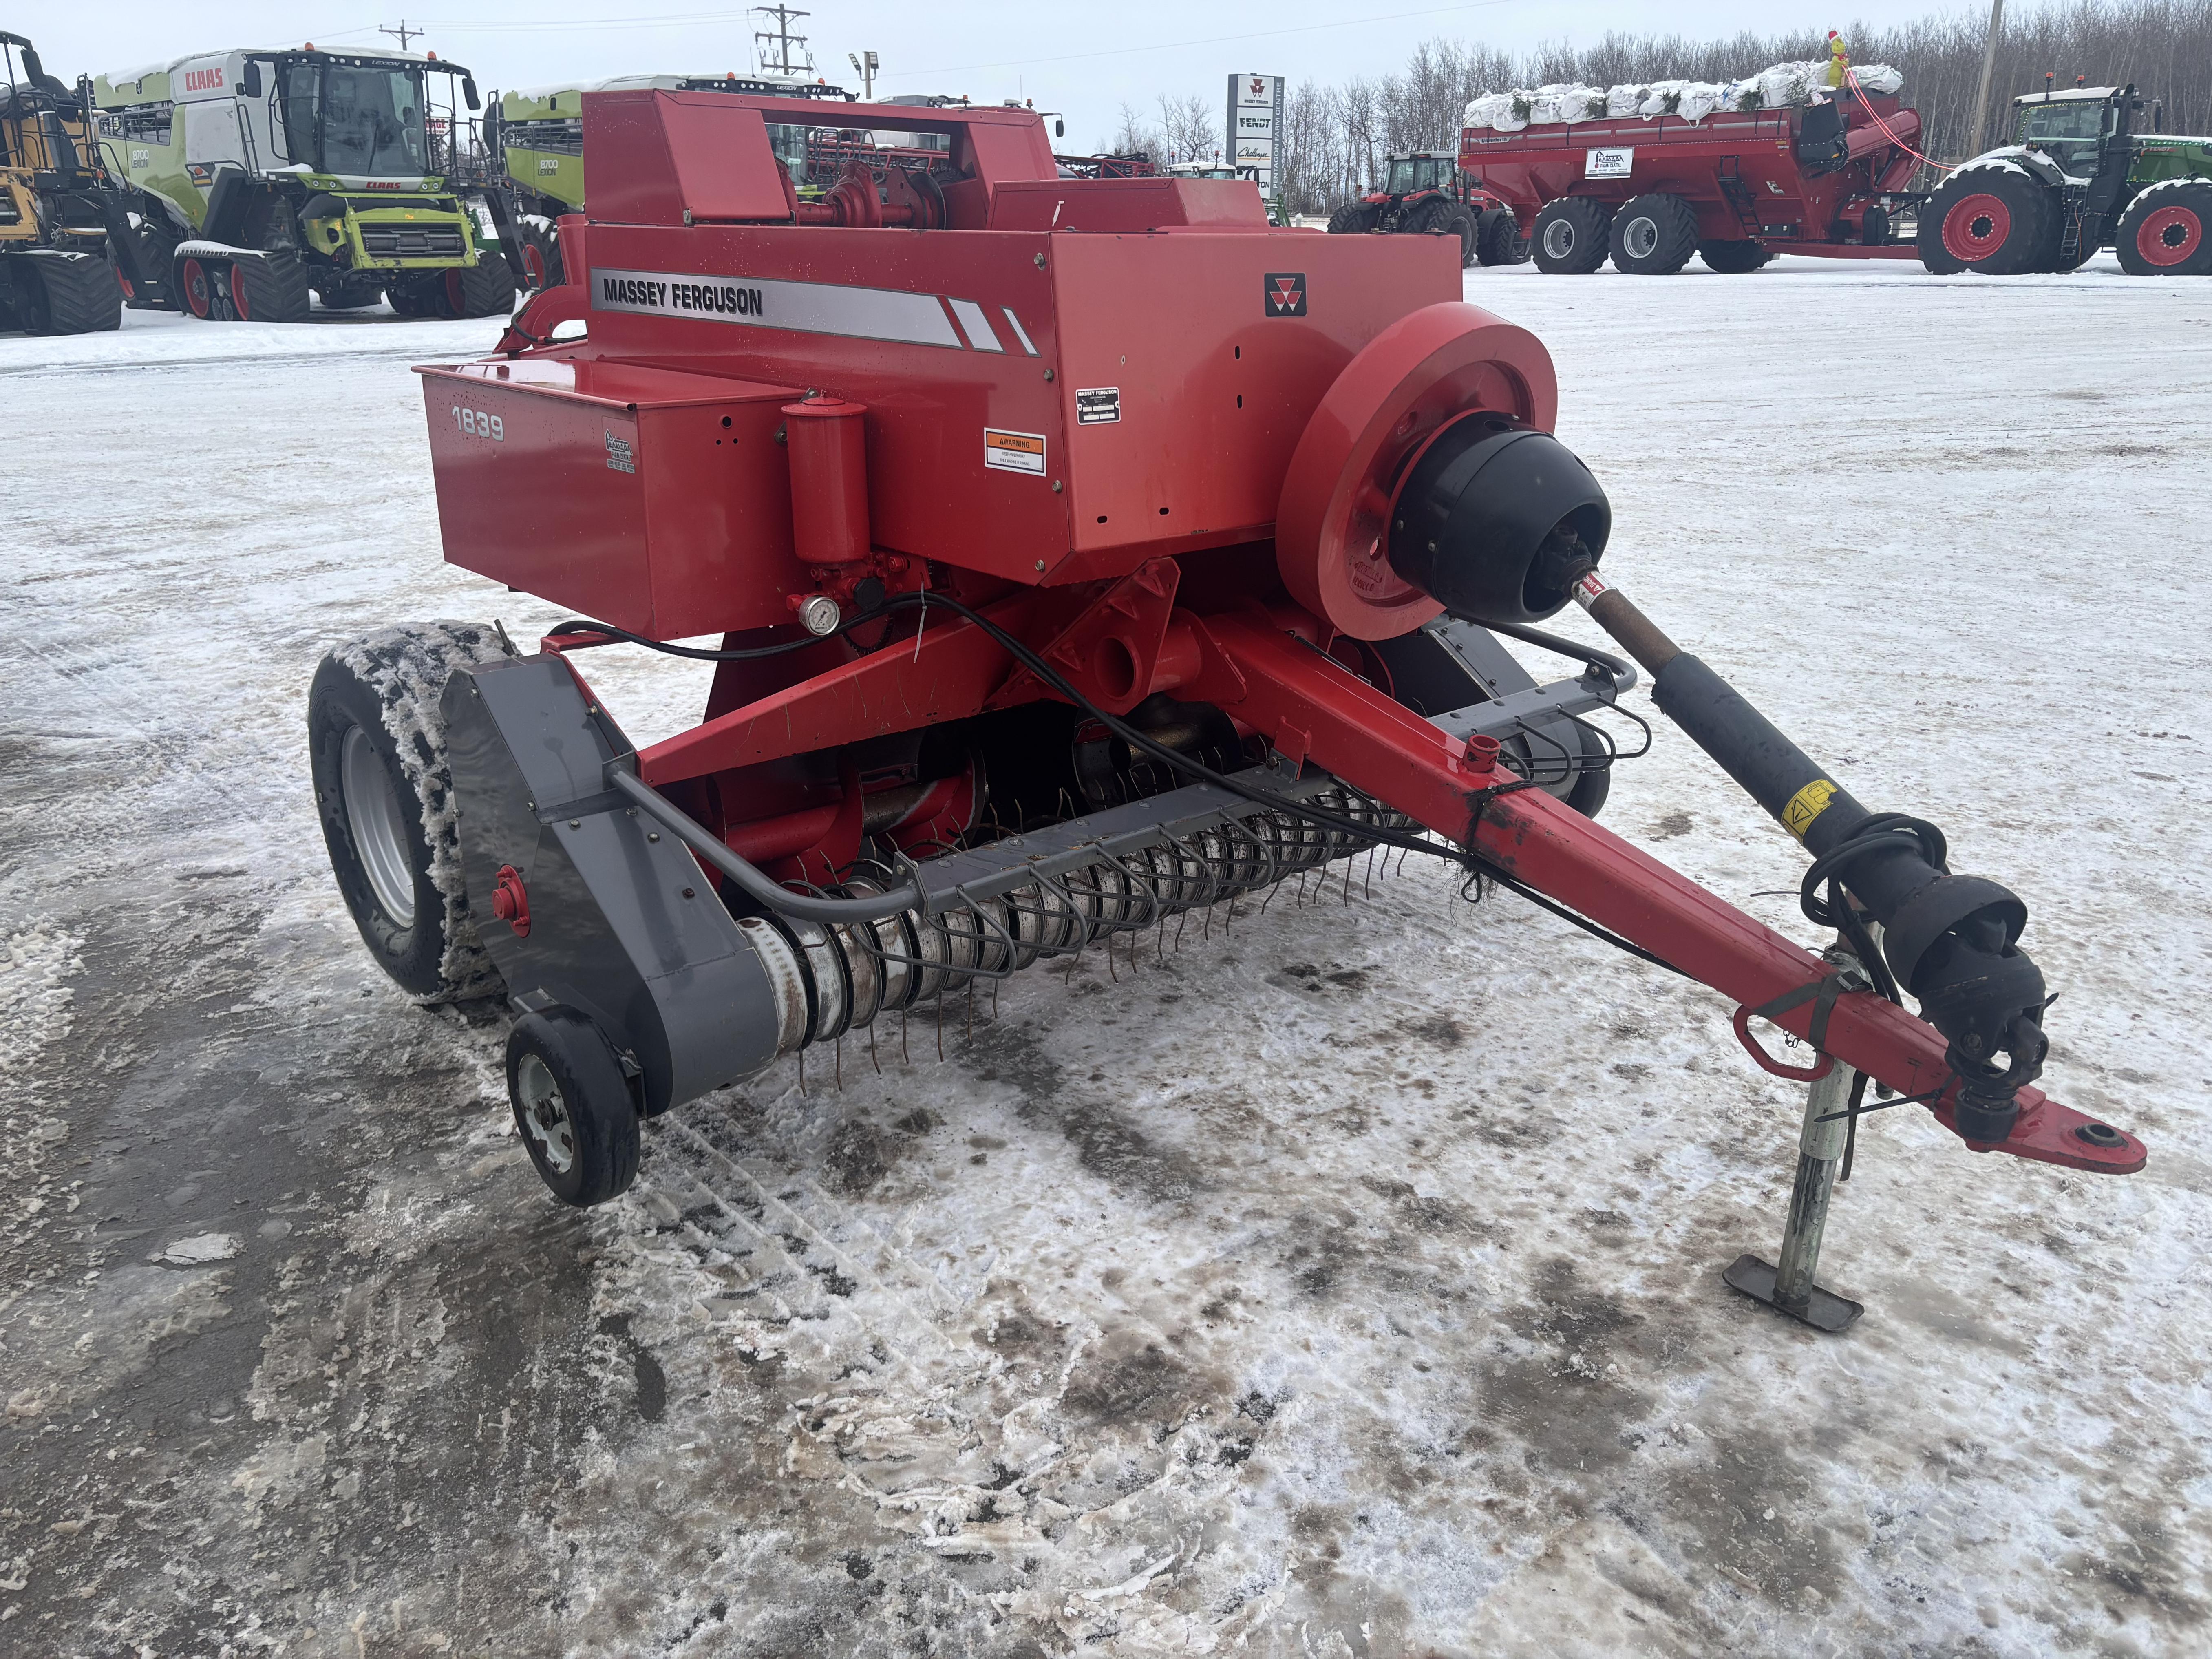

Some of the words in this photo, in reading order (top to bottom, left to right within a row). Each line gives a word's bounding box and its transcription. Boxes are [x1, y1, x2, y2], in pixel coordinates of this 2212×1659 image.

[185, 68, 223, 91] CLAAS
[1239, 118, 1271, 128] FENDT
[133, 150, 149, 160] 8700
[1237, 147, 1270, 161] Challenger
[1596, 151, 1624, 163] Pentagon
[131, 159, 148, 168] LEXION
[541, 159, 558, 169] 8700
[604, 278, 667, 307] MASSEY
[672, 283, 763, 317] FERGUSON
[452, 406, 504, 442] 1839
[1004, 438, 1030, 448] WARNING
